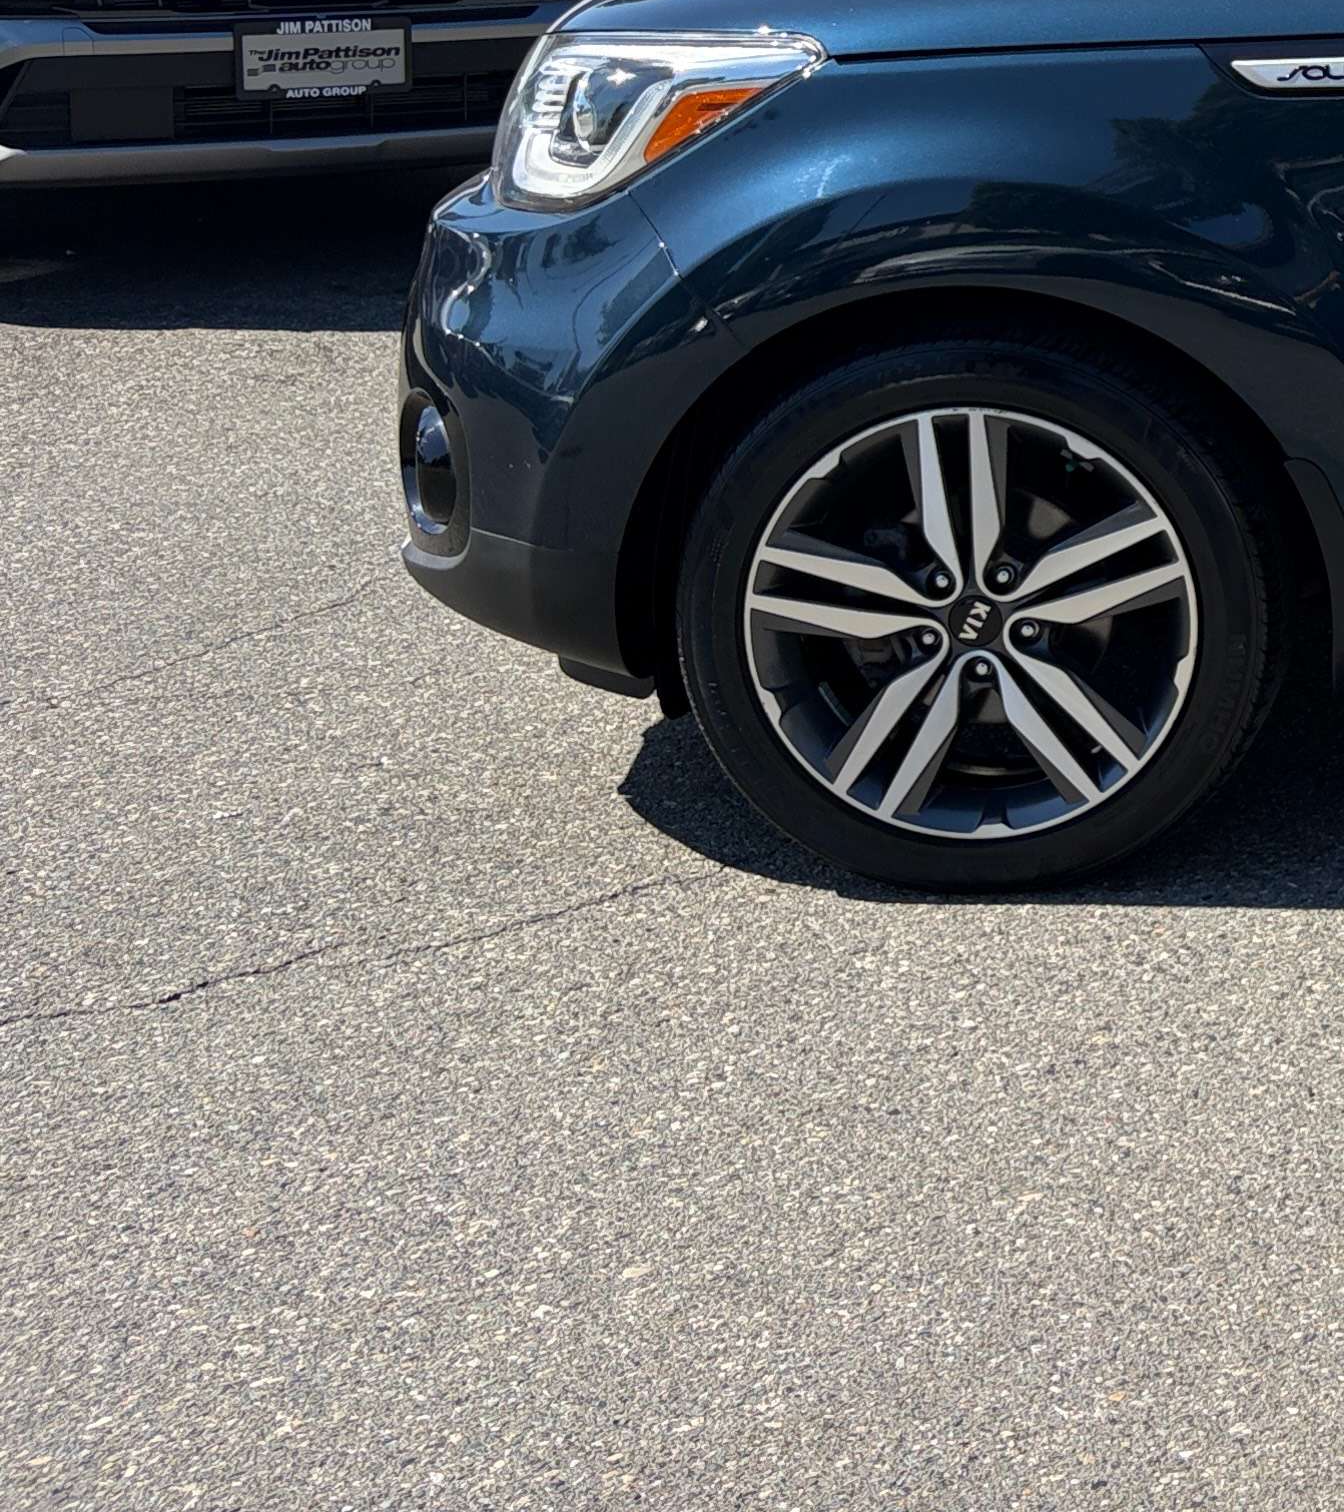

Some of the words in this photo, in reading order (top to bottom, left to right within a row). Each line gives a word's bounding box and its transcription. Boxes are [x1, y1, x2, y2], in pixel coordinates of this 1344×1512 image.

[276, 21, 301, 35] JIM
[305, 18, 372, 34] PATTISON
[286, 88, 320, 99] AUTO
[322, 85, 368, 97] GROUP
[958, 600, 992, 641] KIA
